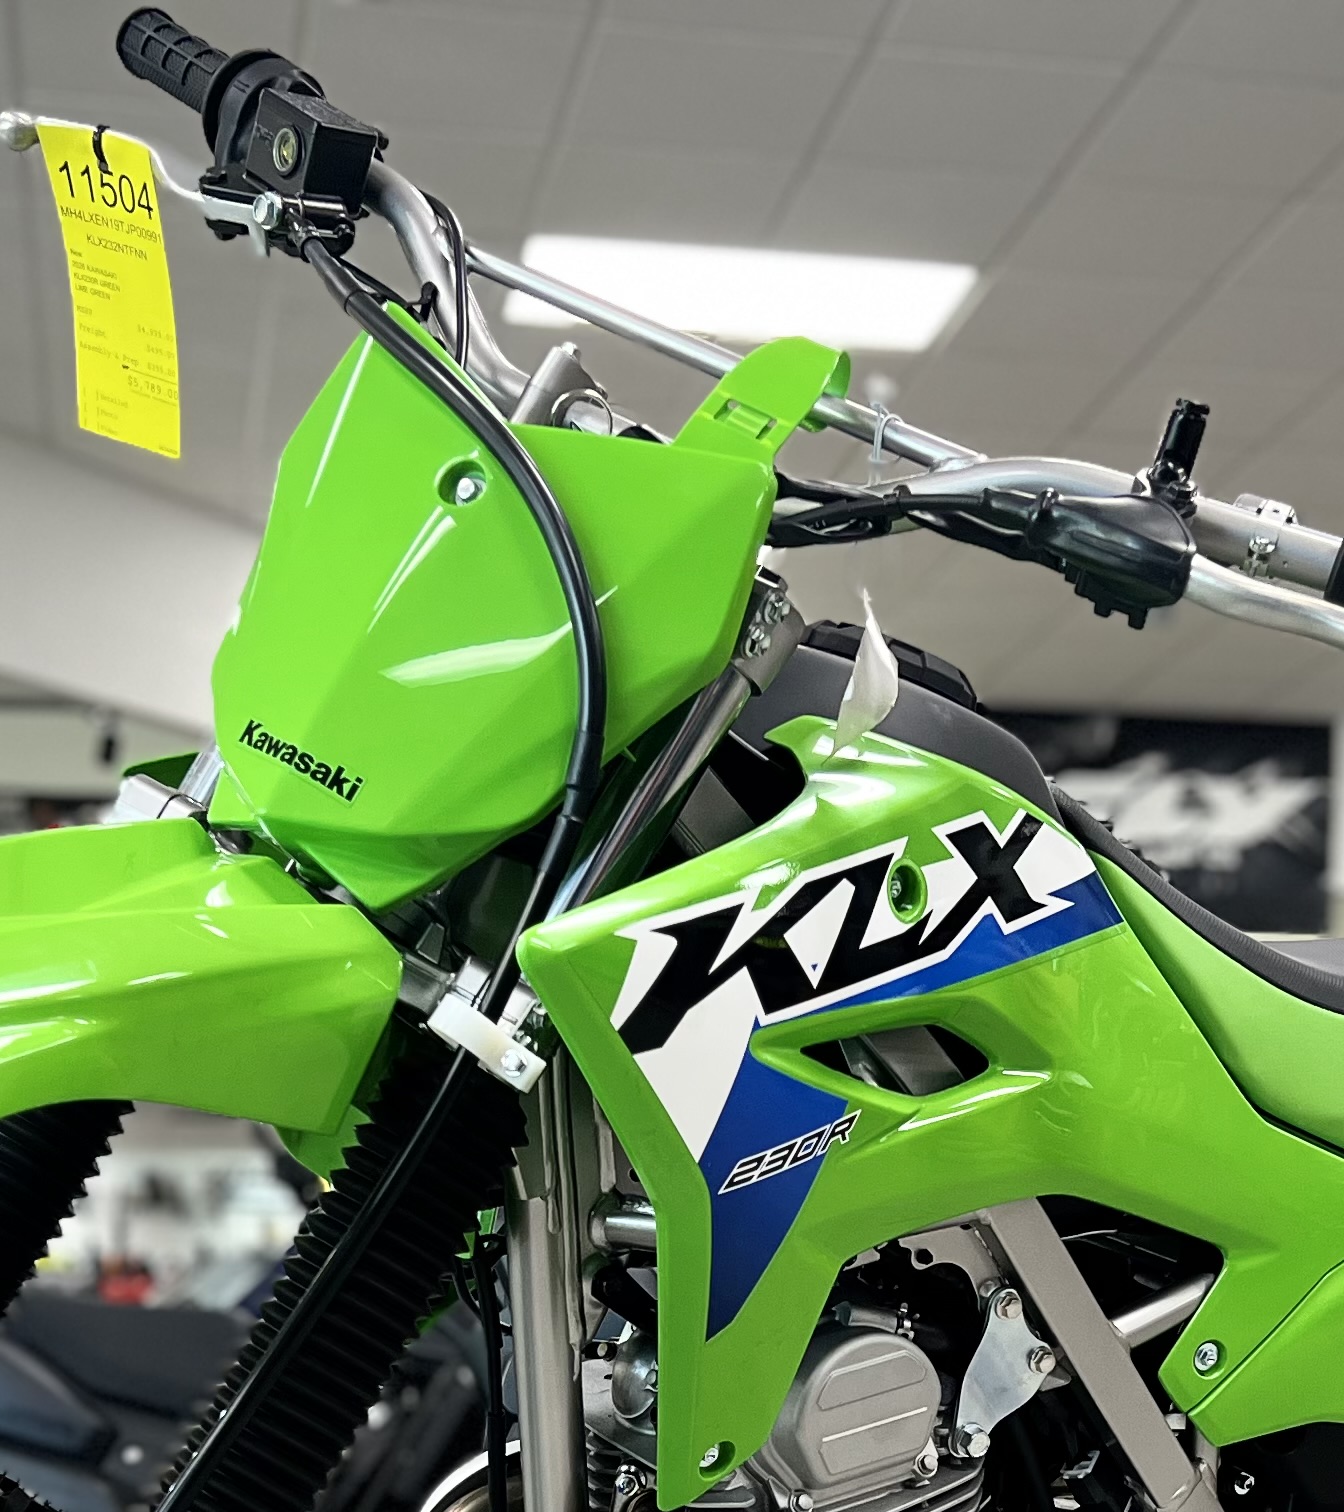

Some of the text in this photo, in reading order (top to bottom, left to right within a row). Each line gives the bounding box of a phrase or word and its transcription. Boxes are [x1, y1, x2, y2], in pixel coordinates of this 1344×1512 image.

[58, 160, 155, 220] 11504
[238, 719, 364, 802] Kawasaki
[615, 809, 1051, 1050] KLX
[719, 1110, 861, 1194] 230R
